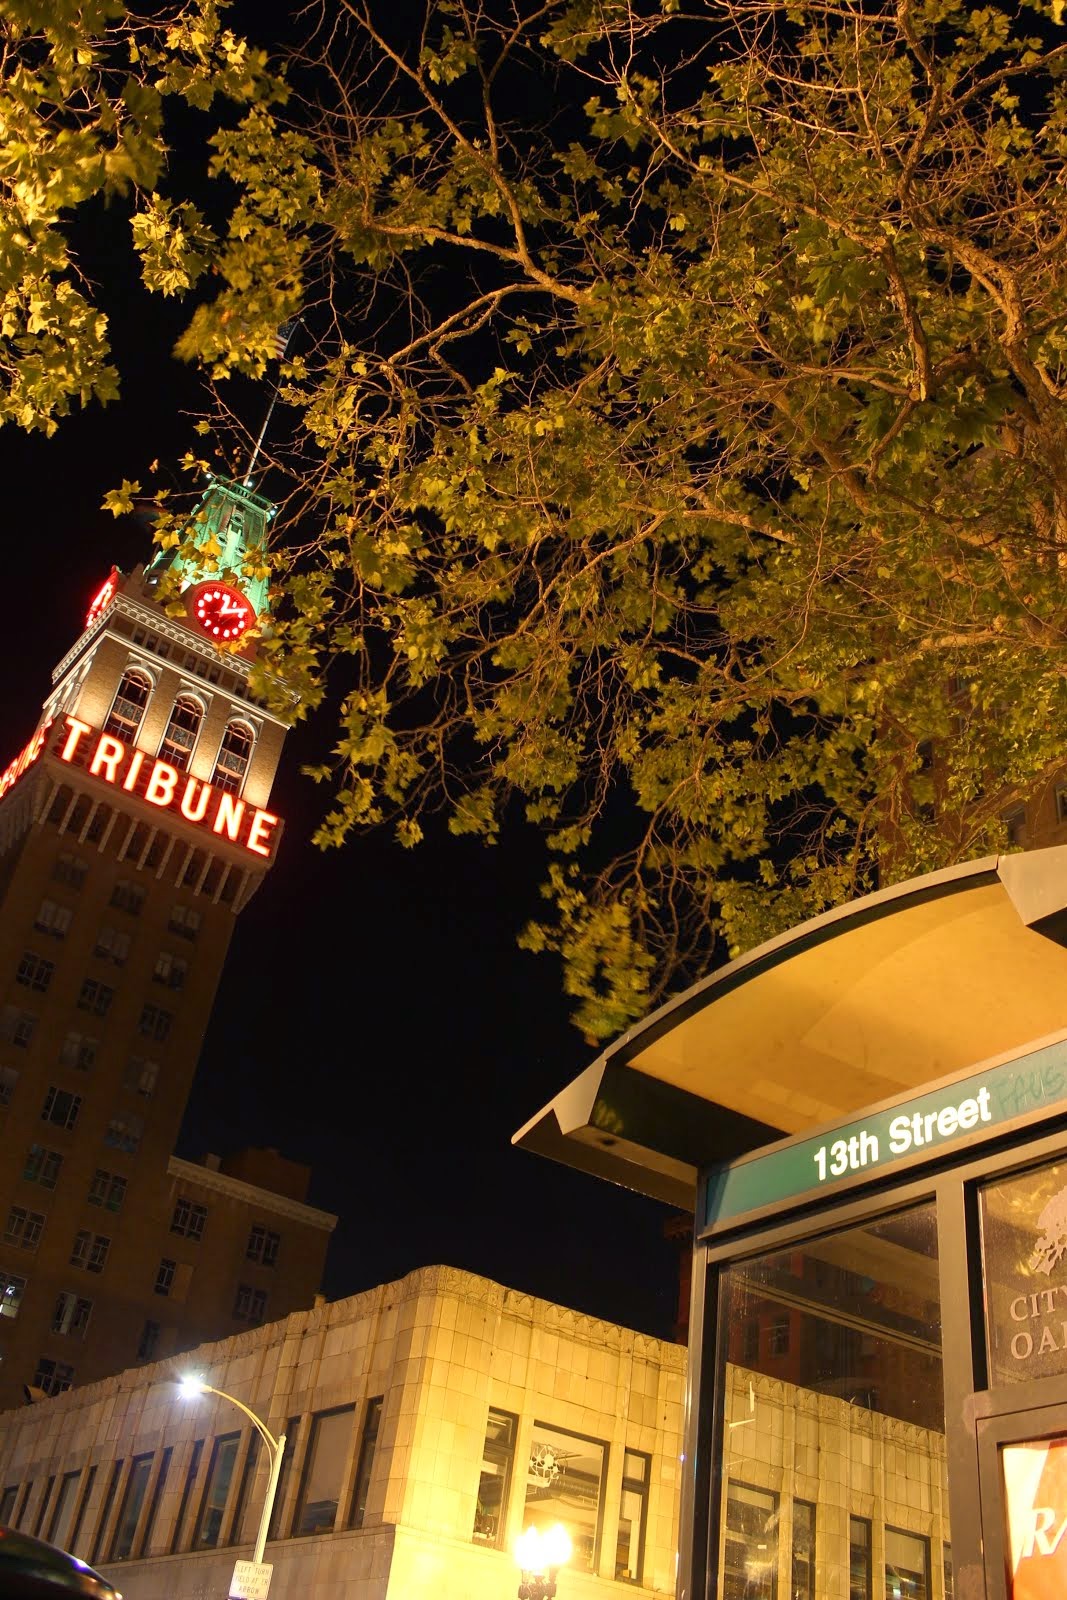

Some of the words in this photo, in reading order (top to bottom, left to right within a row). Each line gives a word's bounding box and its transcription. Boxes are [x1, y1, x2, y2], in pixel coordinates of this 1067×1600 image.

[60, 715, 280, 858] TRIBUNE
[813, 1130, 880, 1182] 13th
[888, 1086, 993, 1154] Street
